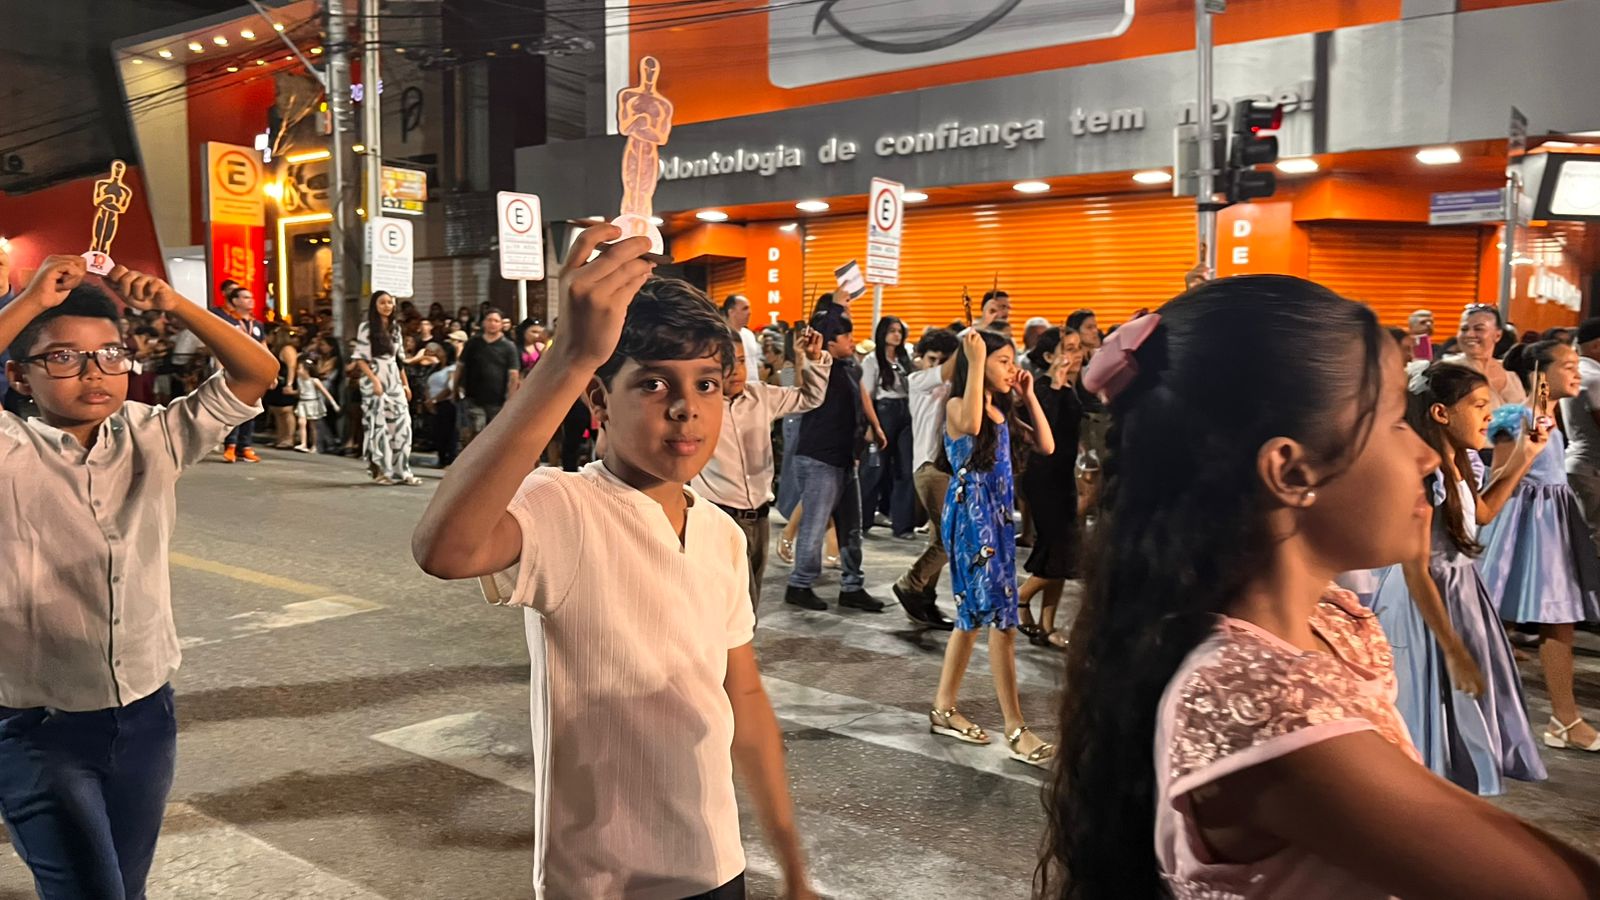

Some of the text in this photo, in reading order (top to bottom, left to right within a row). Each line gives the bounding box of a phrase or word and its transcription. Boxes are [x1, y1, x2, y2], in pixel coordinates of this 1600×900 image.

[818, 137, 857, 163] de
[875, 118, 1046, 156] confiança
[1069, 107, 1145, 136] tem
[1178, 81, 1312, 125] noe!
[227, 160, 246, 186] E
[515, 208, 524, 225] E
[881, 199, 890, 221] E
[388, 230, 397, 247] E
